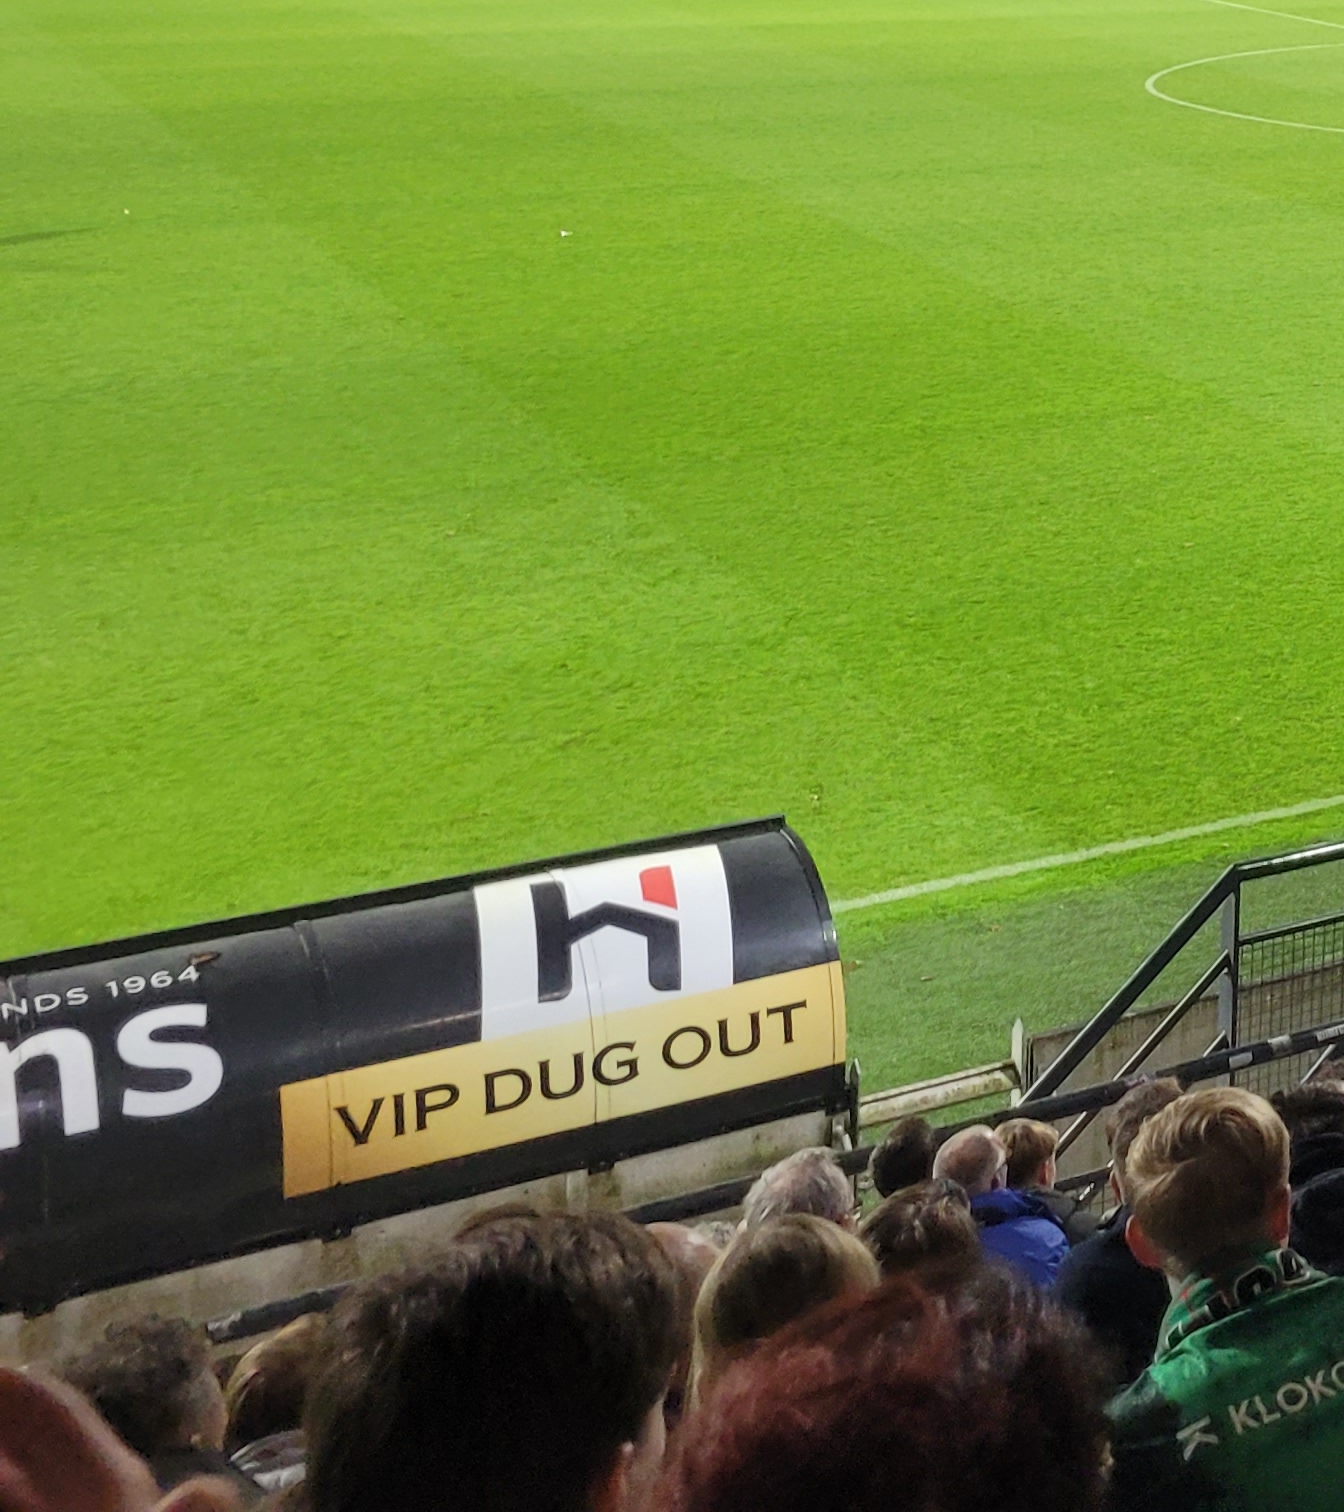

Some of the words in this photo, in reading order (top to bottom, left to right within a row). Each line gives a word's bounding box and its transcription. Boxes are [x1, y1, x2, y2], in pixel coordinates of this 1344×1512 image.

[106, 962, 202, 1000] 1964
[335, 1083, 461, 1147] VIP
[484, 1039, 641, 1116] DUG
[661, 998, 810, 1071] OUT
